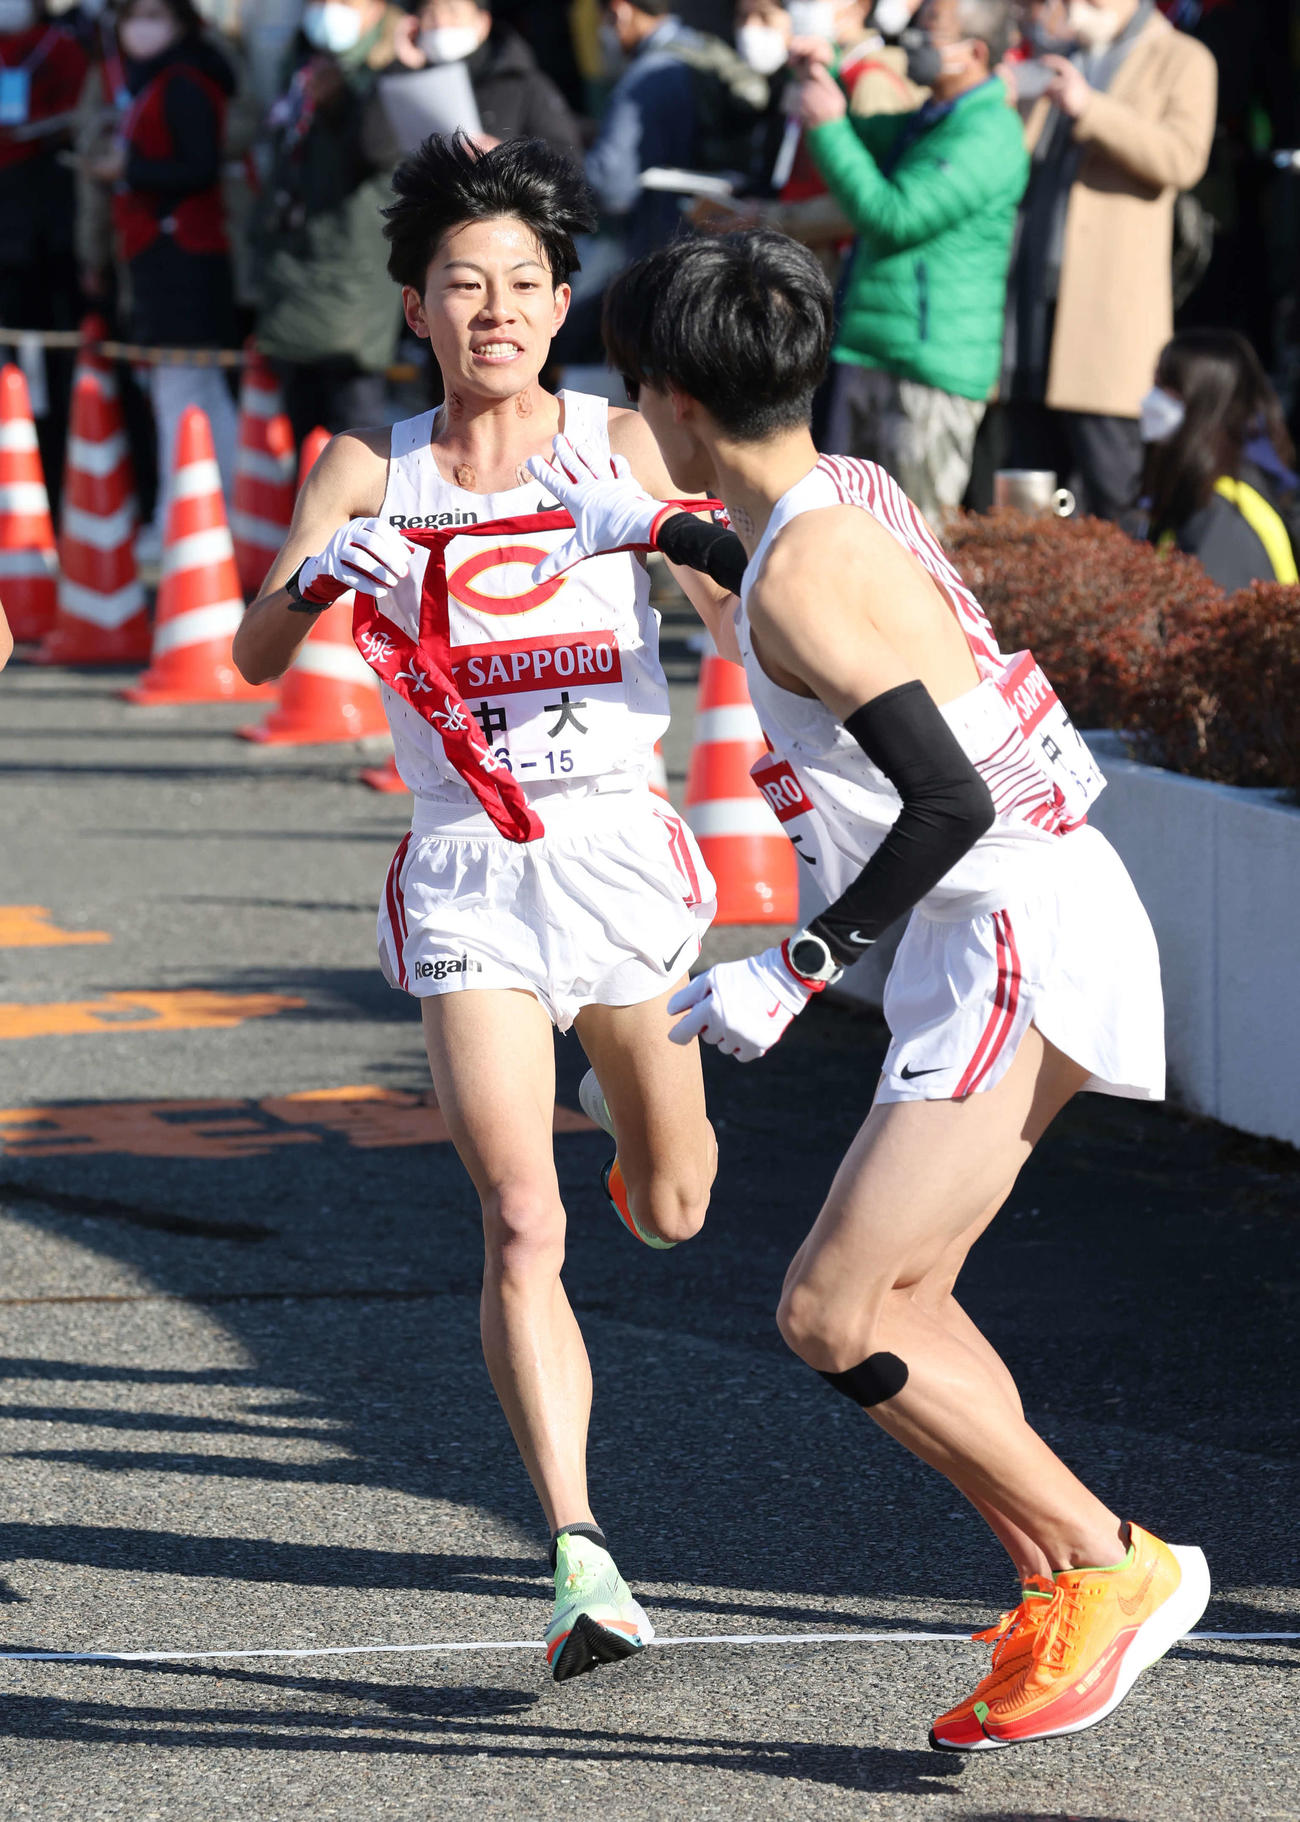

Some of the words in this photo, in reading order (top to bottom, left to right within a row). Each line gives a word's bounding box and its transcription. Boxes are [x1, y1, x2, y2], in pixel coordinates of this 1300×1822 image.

[389, 508, 478, 530] Regain
[467, 643, 613, 687] SAPPORO
[414, 953, 483, 980] Regain
